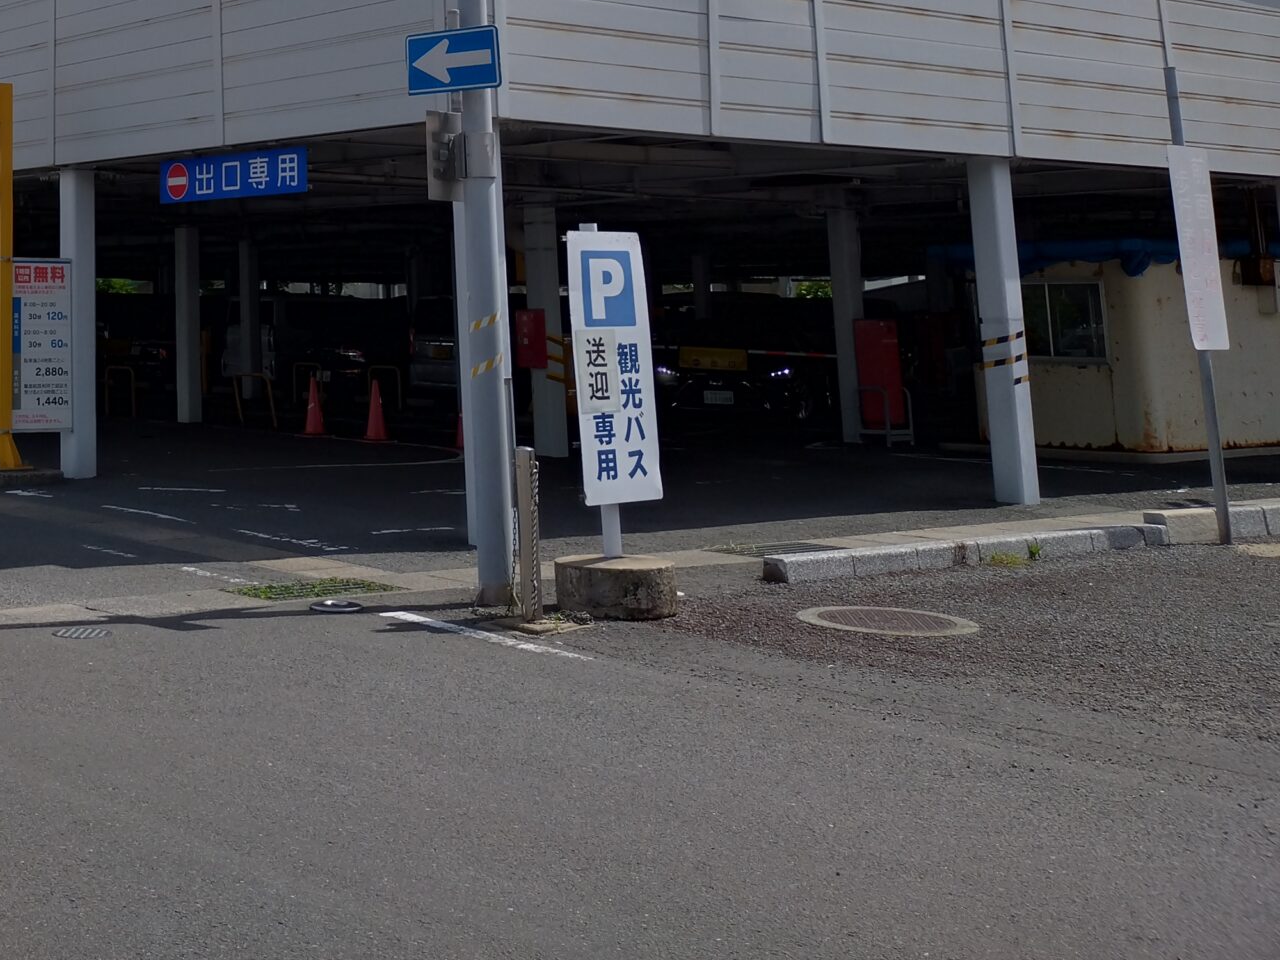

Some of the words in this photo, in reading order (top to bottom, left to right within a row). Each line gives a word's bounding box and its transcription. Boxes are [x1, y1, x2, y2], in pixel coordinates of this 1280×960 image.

[195, 154, 298, 195] 出口専用
[33, 266, 65, 283] 無料
[588, 258, 625, 320] P
[35, 367, 69, 376] 2,880円
[36, 397, 69, 406] 1,440円
[586, 337, 618, 481] 送迎専用
[616, 343, 648, 479] 観光バス
